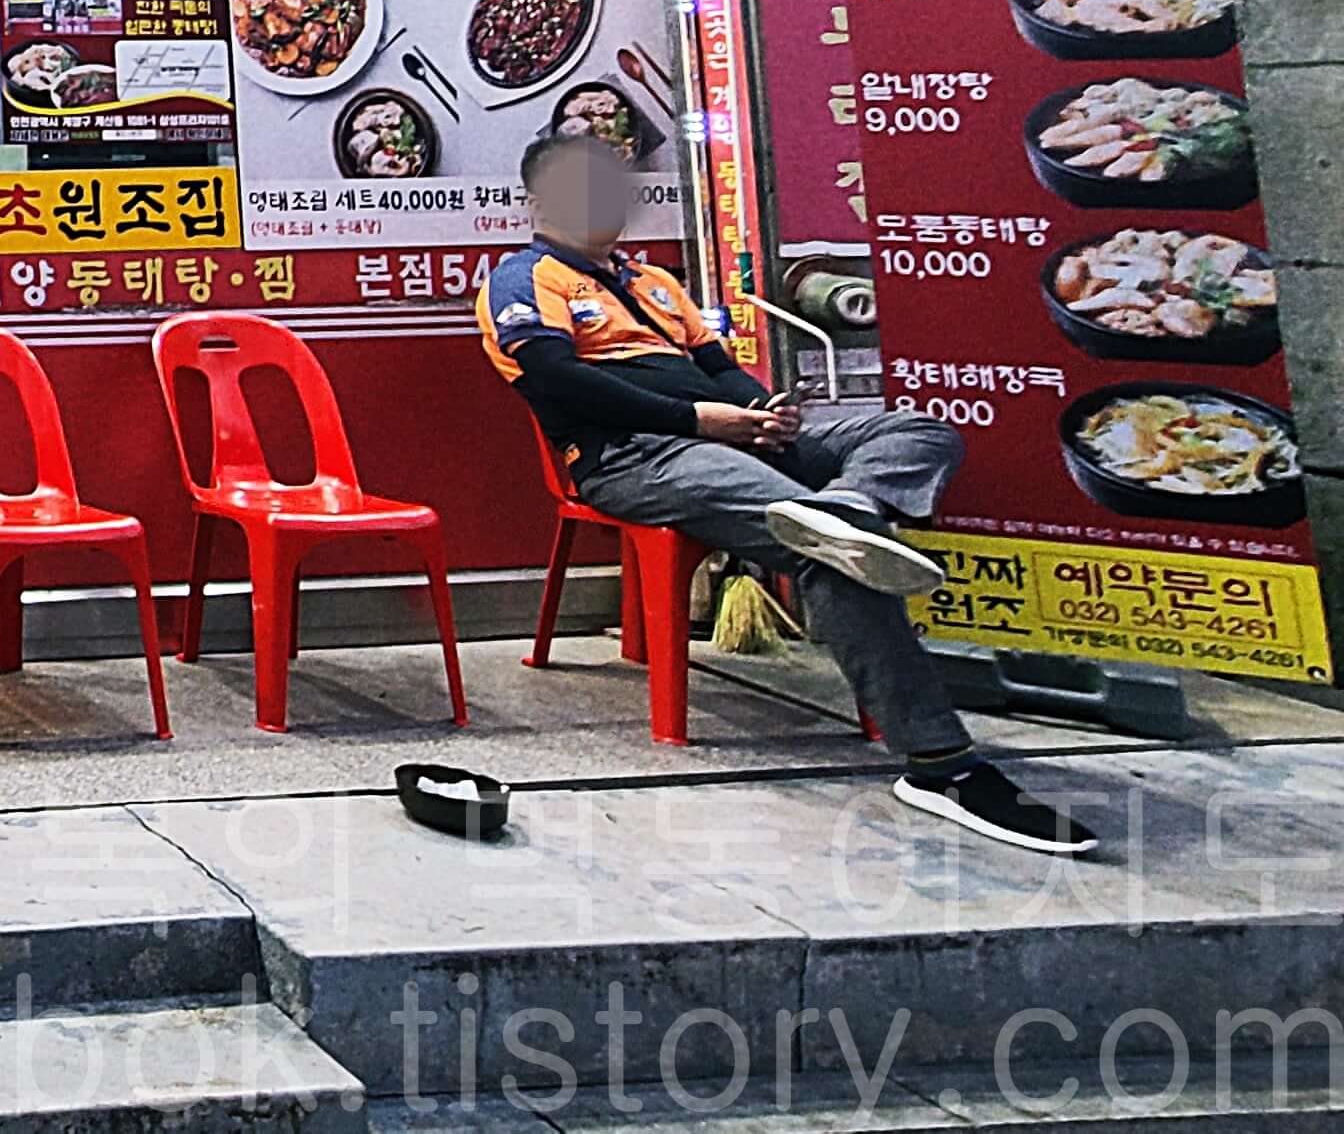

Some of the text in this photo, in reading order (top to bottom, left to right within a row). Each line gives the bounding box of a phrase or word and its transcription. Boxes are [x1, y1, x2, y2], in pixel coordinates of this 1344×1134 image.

[860, 70, 994, 103] 알내장탕
[864, 106, 961, 137] 9,000
[248, 190, 328, 213] 명태조림
[879, 248, 993, 281] 10,000
[890, 358, 1068, 398] 황태해장국
[1053, 561, 1274, 617] 예약문의
[926, 587, 1033, 636] 원조
[1059, 599, 1279, 641] 032) 543-4261
[1191, 639, 1305, 669] 543-4261
